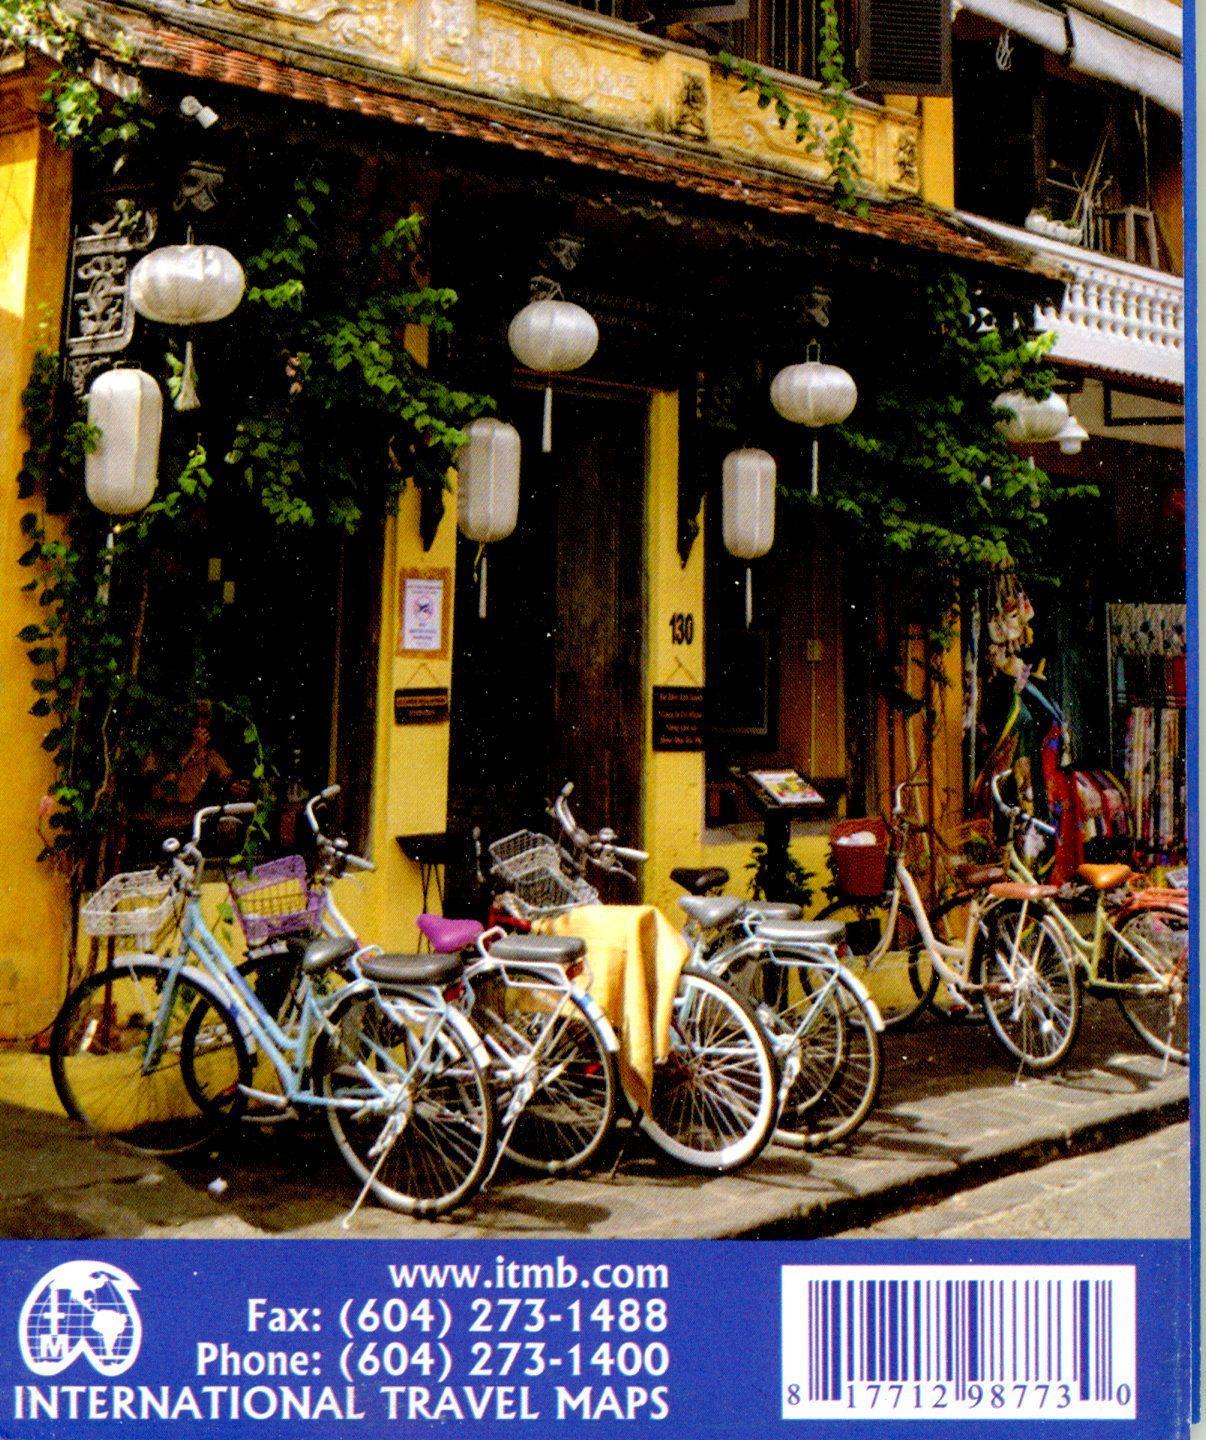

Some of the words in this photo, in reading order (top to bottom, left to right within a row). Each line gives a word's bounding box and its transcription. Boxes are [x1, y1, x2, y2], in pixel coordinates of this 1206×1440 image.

[669, 613, 695, 646] 130
[388, 1254, 669, 1289] www.itmb.com
[247, 1297, 322, 1333] Fax:
[338, 1297, 452, 1338] (604)
[468, 1297, 669, 1333] 273-1488
[196, 1341, 322, 1376] Phone:
[338, 1341, 452, 1382] (604)
[468, 1341, 670, 1377] 273-1400
[13, 1385, 366, 1420] INTERNATIONAL
[380, 1385, 540, 1420] TRAVEL
[555, 1385, 669, 1420] MAPS
